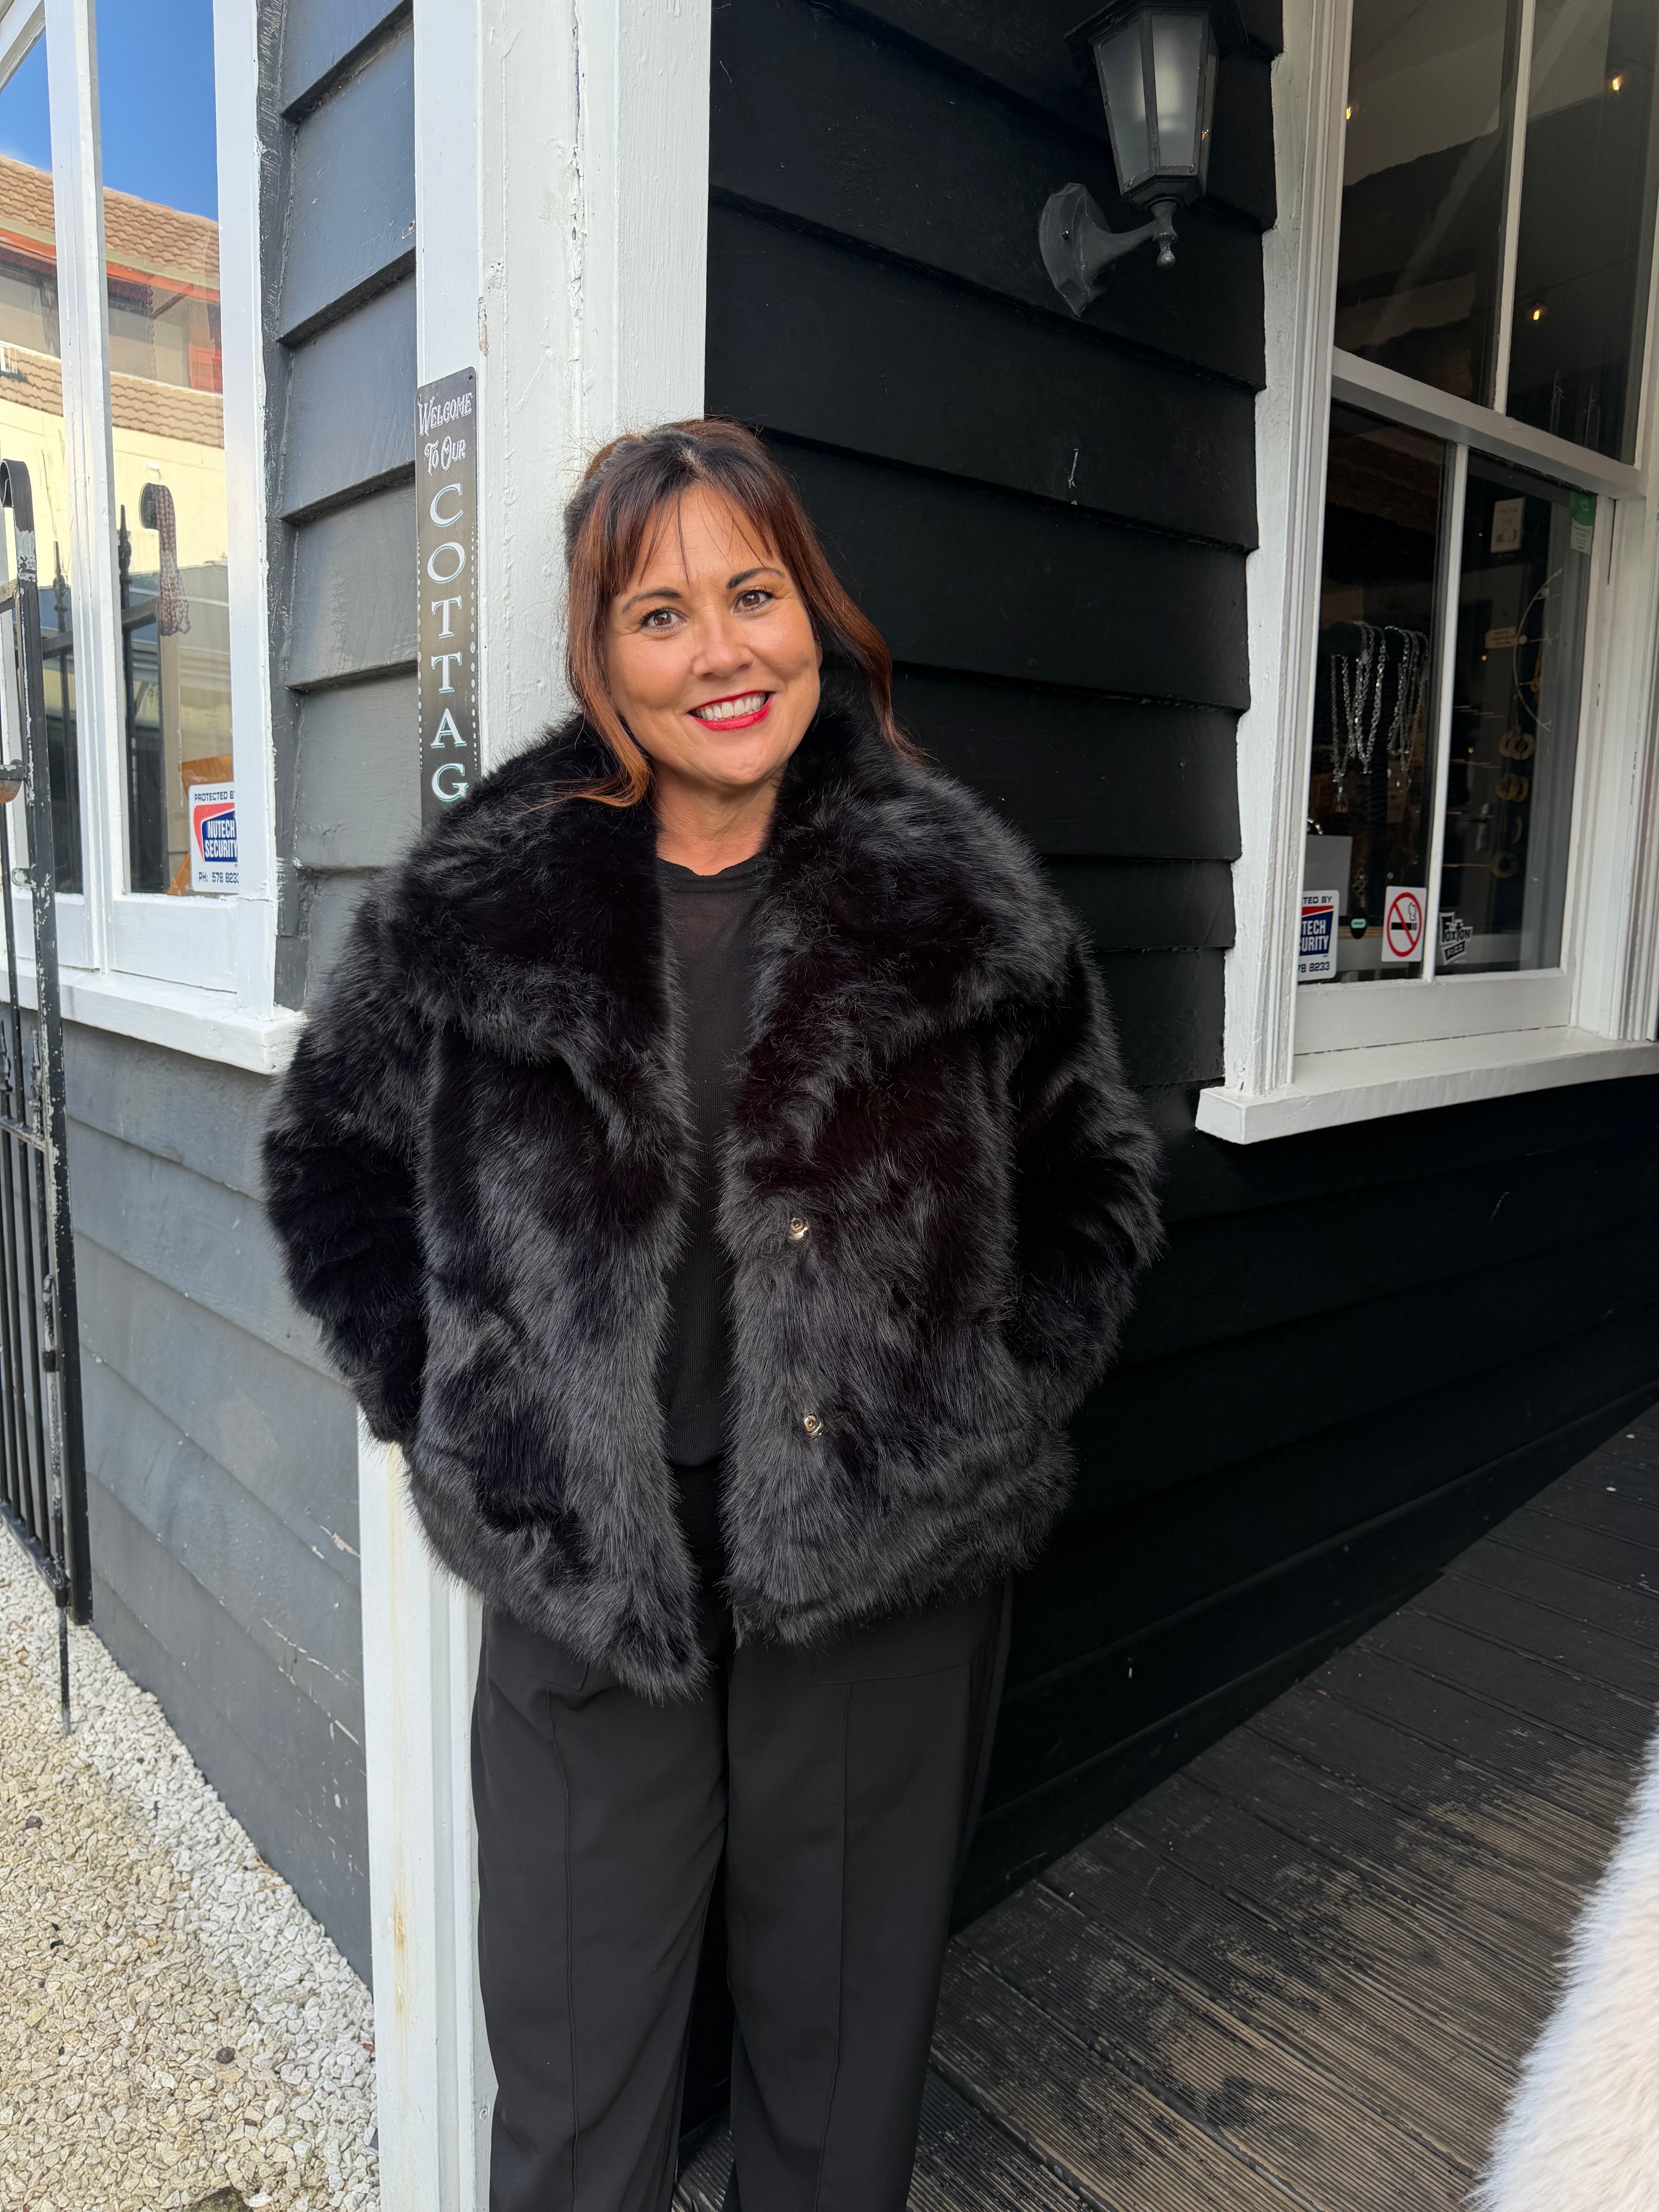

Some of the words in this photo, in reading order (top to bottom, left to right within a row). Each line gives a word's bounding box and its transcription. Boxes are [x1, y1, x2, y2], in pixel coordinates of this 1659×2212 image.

[427, 483, 468, 803] COTTAG
[194, 791, 228, 802] PROTECTED
[229, 790, 235, 799] B
[207, 820, 235, 839] NUTECH
[205, 839, 238, 858] SECURITY
[199, 871, 208, 883] PH:
[212, 872, 223, 883] 578
[1302, 919, 1327, 936] TECH
[1300, 935, 1329, 952] URITY
[1309, 962, 1330, 972] 8233
